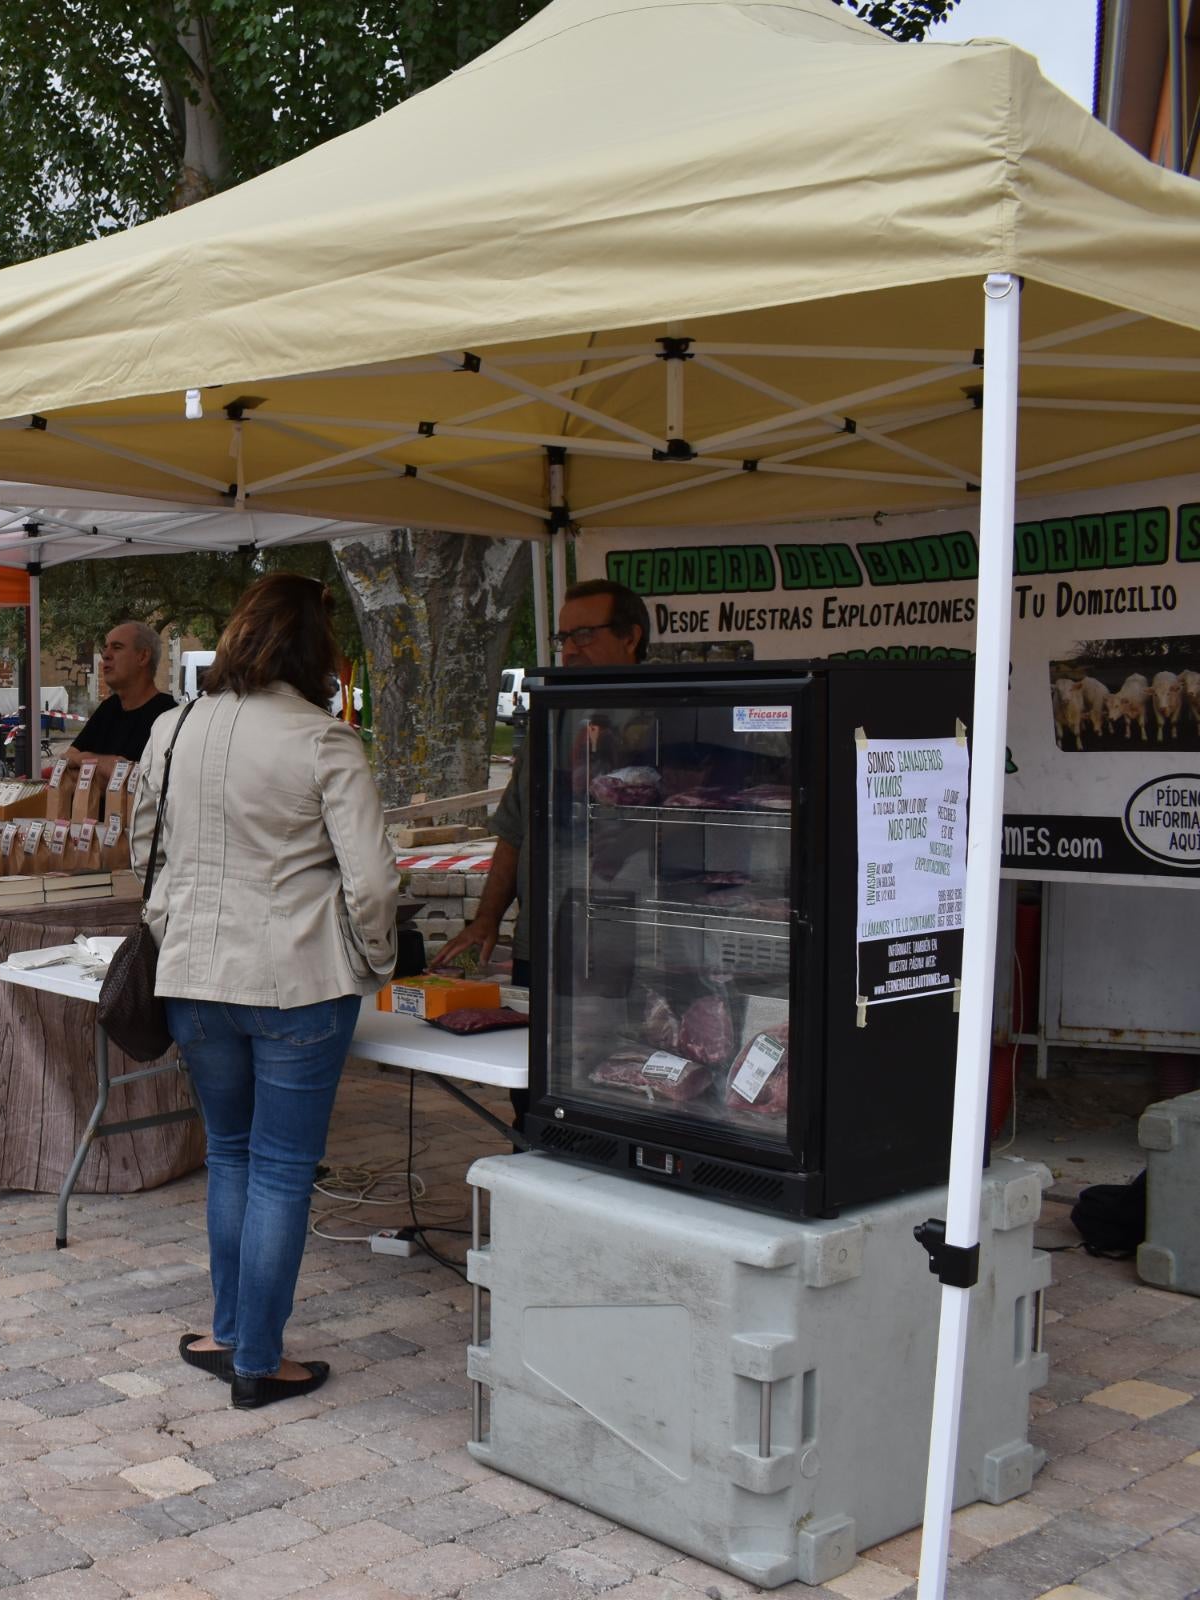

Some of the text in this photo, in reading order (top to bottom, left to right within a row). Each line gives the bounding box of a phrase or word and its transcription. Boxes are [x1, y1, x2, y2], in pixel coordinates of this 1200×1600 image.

[611, 553, 770, 589] TERNERA
[787, 550, 854, 582] DEL
[863, 538, 972, 571] BAJO
[1020, 518, 1160, 565] ORMES
[718, 601, 813, 632] NUESTRAS
[822, 596, 975, 629] EXPLOTACIONES
[748, 708, 789, 719] Fricarsa
[868, 749, 943, 774] SOMOS GANADEROS
[867, 775, 902, 798] Y VAMOS
[1156, 785, 1200, 808] PÍDEN
[897, 799, 908, 815] CON
[909, 798, 916, 814] LO
[917, 798, 928, 815] QUE
[938, 806, 956, 822] RECIBES
[888, 817, 927, 841] NOS PIDAS
[930, 841, 952, 858] NUESTRAS
[866, 862, 876, 906] ENVASADO
[862, 919, 889, 938] LLÁMANOS
